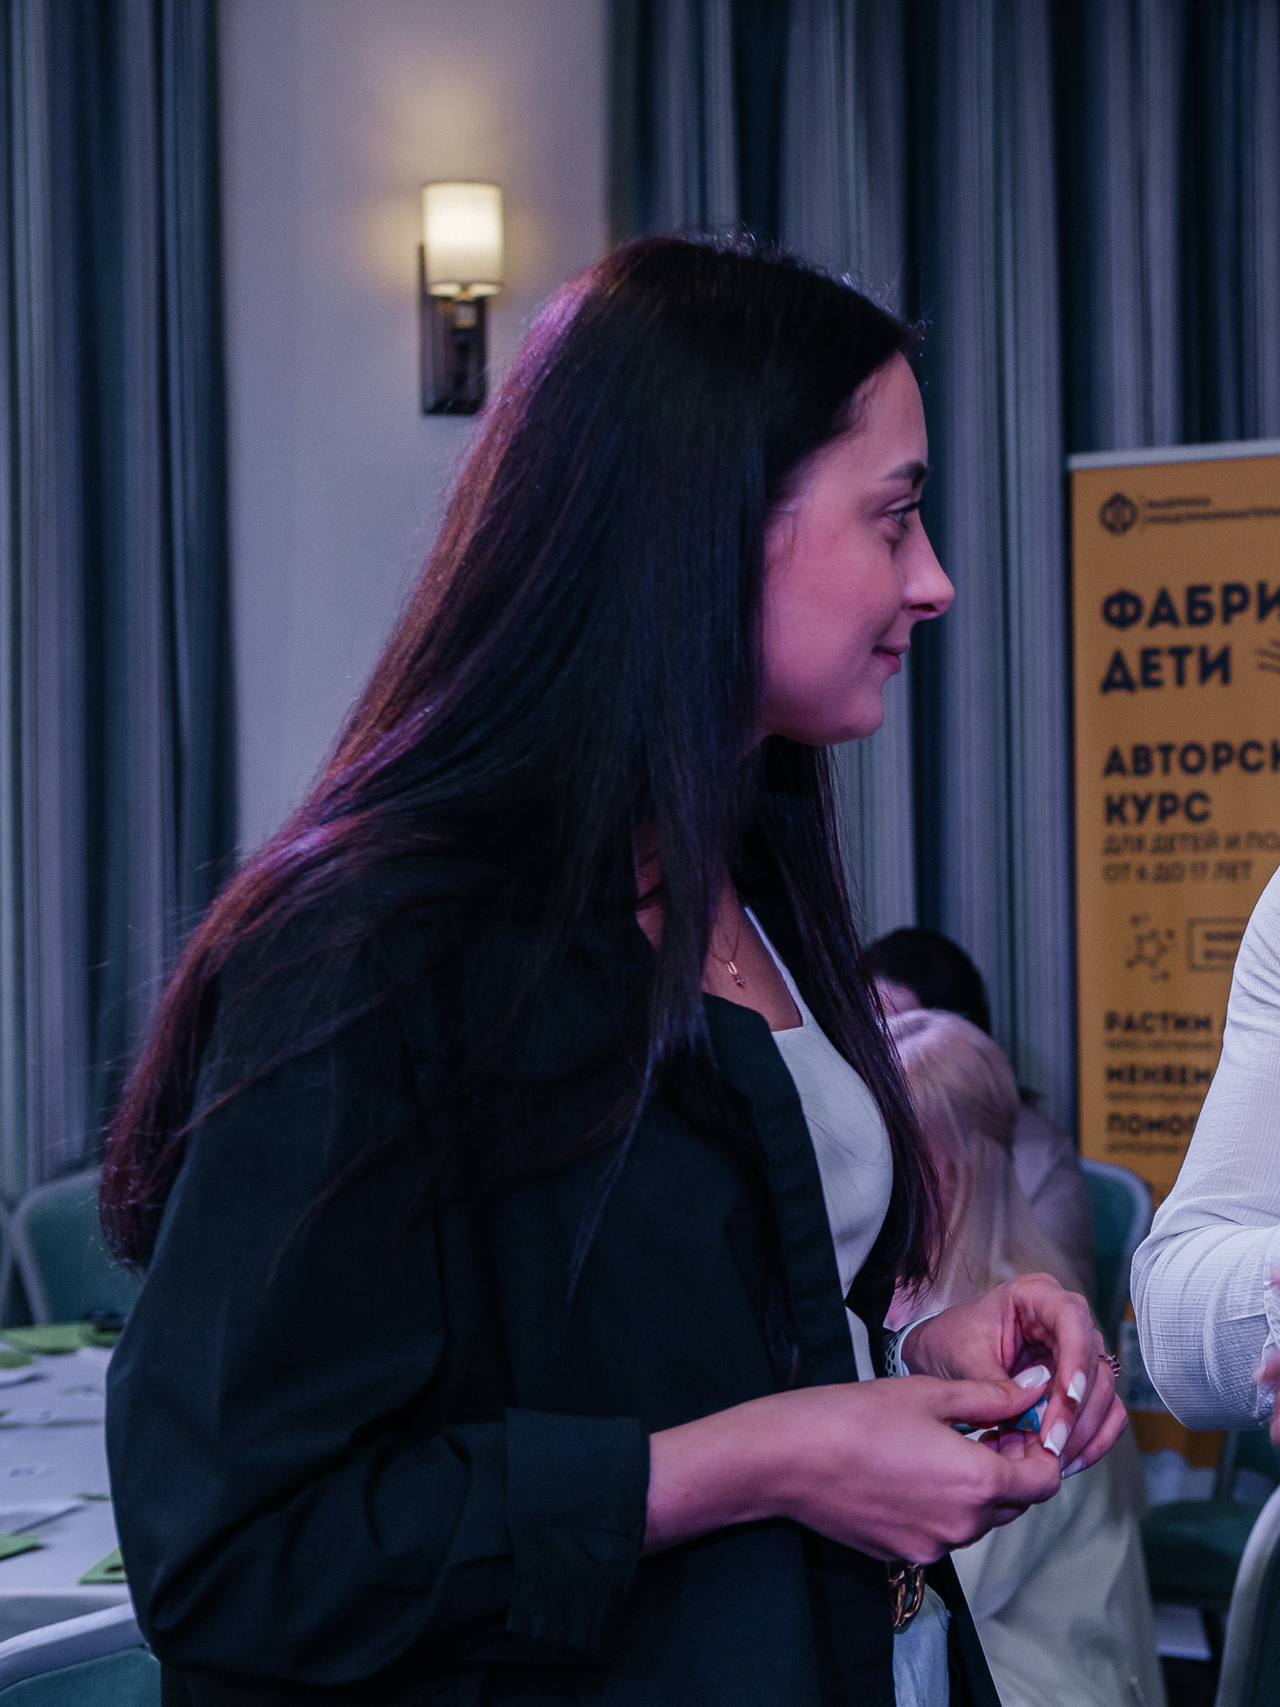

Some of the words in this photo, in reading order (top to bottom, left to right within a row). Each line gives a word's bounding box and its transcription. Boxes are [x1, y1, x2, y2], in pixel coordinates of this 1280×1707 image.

[1102, 645, 1232, 693] ДЕТИ
[1106, 792, 1210, 825] КУРС
[1106, 1011, 1211, 1033] РАСТИМ
[1107, 1064, 1211, 1086] МЕНЯЕМ
